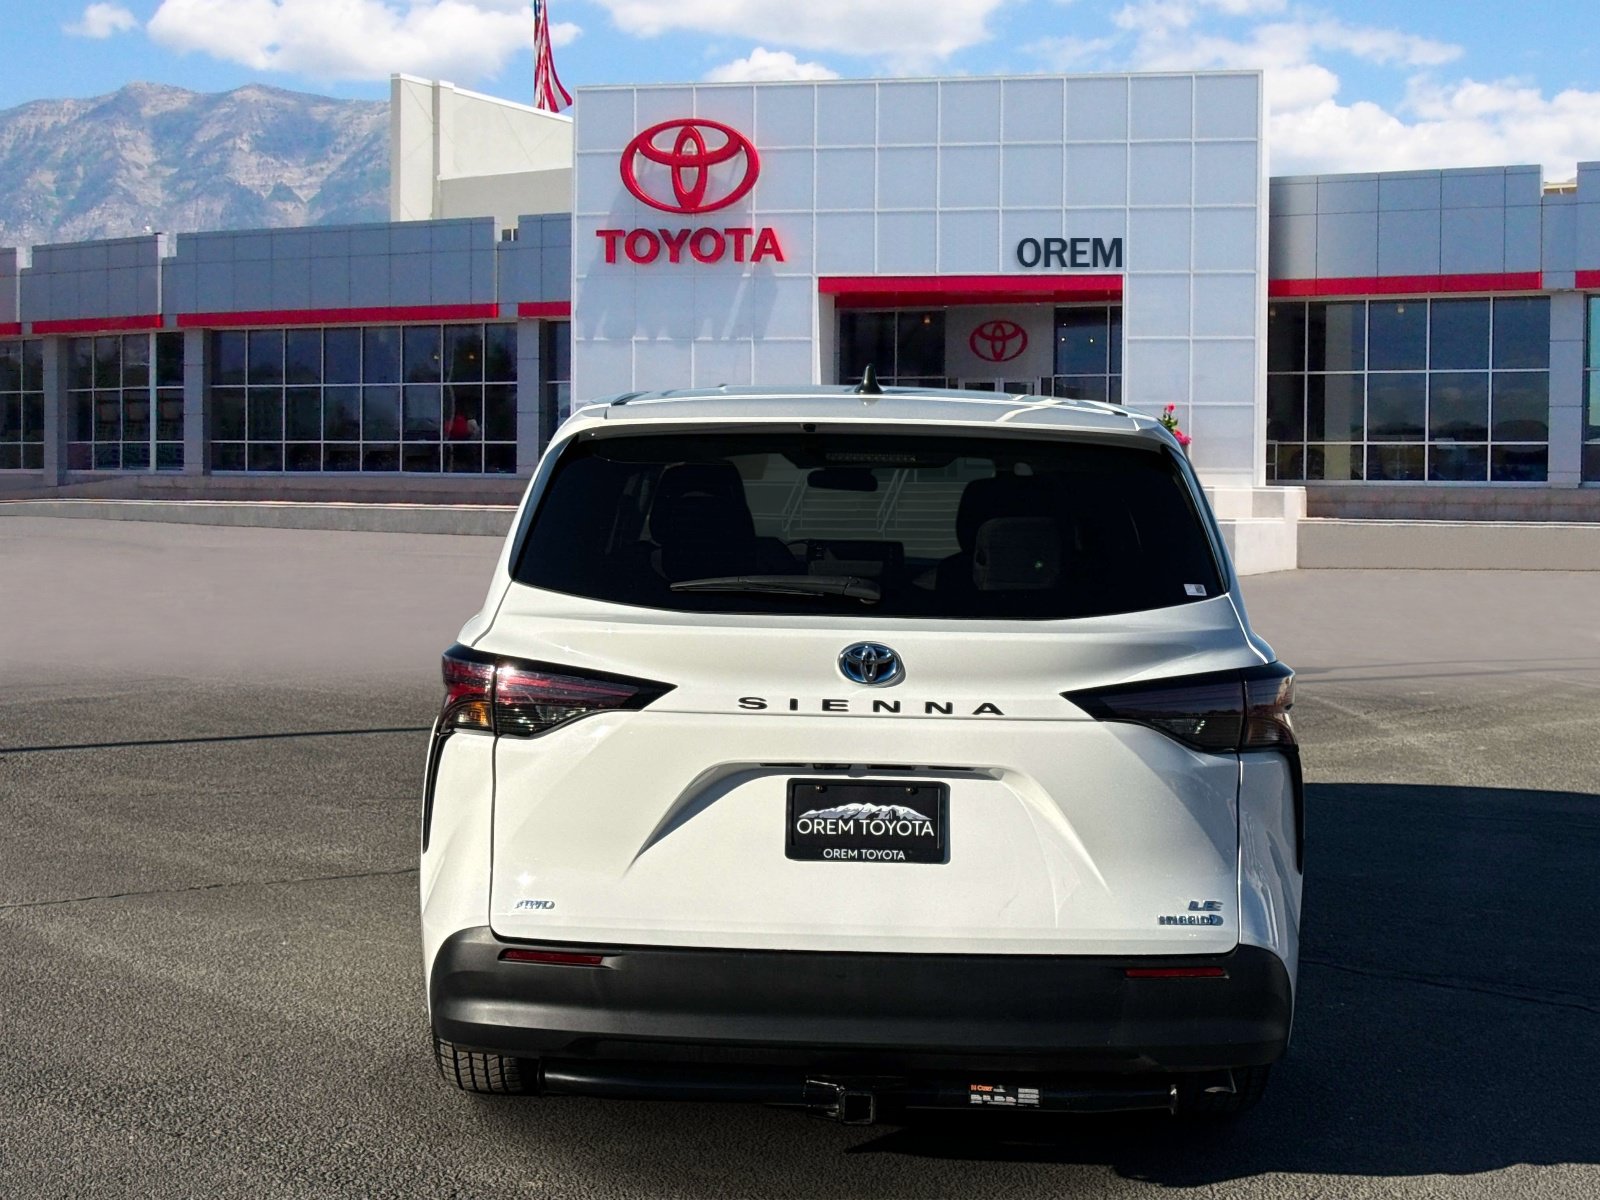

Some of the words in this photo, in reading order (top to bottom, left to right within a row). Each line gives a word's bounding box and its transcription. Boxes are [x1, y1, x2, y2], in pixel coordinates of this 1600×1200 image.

[596, 227, 785, 264] TOYOTA
[1016, 237, 1123, 268] OREM
[738, 696, 1005, 716] SIENNA
[796, 818, 854, 836] OREM
[859, 819, 935, 837] TOYOTA
[823, 848, 858, 860] OREM
[861, 849, 906, 861] TOYOTA
[1188, 900, 1224, 911] LE
